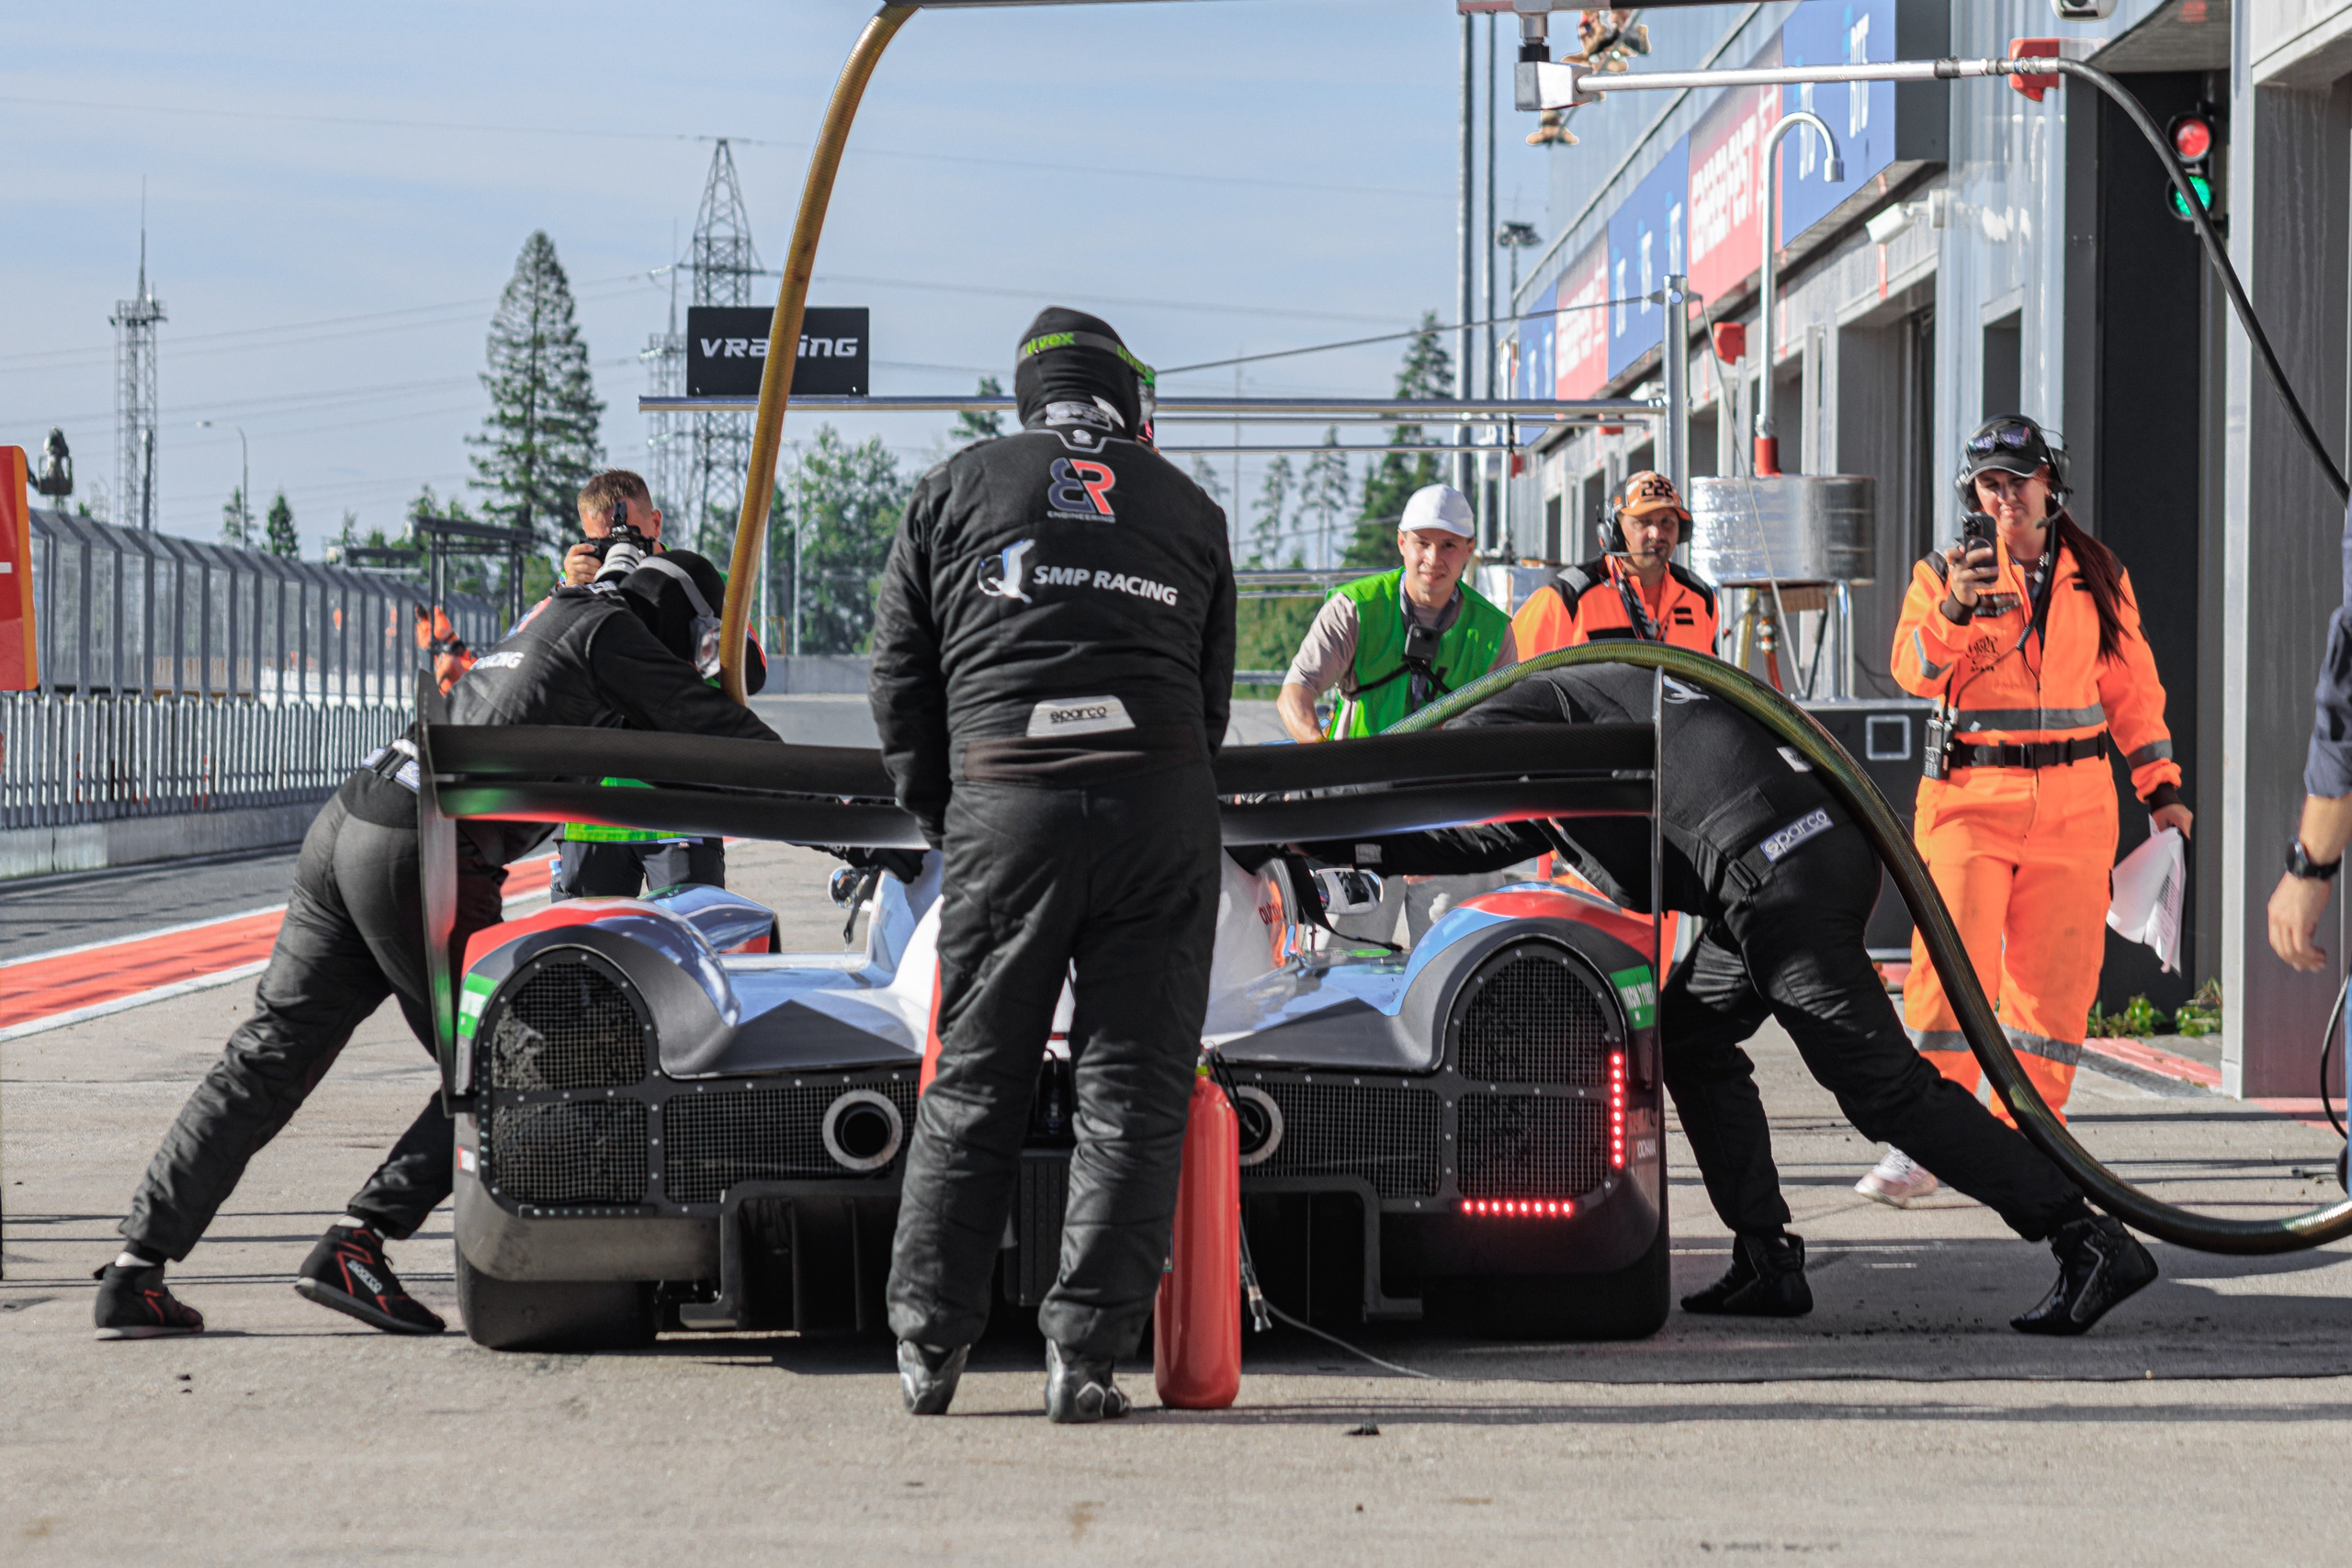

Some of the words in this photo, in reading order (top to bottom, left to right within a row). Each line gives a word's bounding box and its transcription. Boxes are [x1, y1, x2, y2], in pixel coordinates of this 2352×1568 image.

[1025, 332, 1076, 355] uvex
[1641, 479, 1674, 499] 222
[1033, 565, 1091, 587] SMP
[1092, 570, 1179, 606] RACING
[1049, 705, 1107, 724] sparco
[1763, 809, 1829, 860] sparco
[1258, 900, 1286, 926] auto
